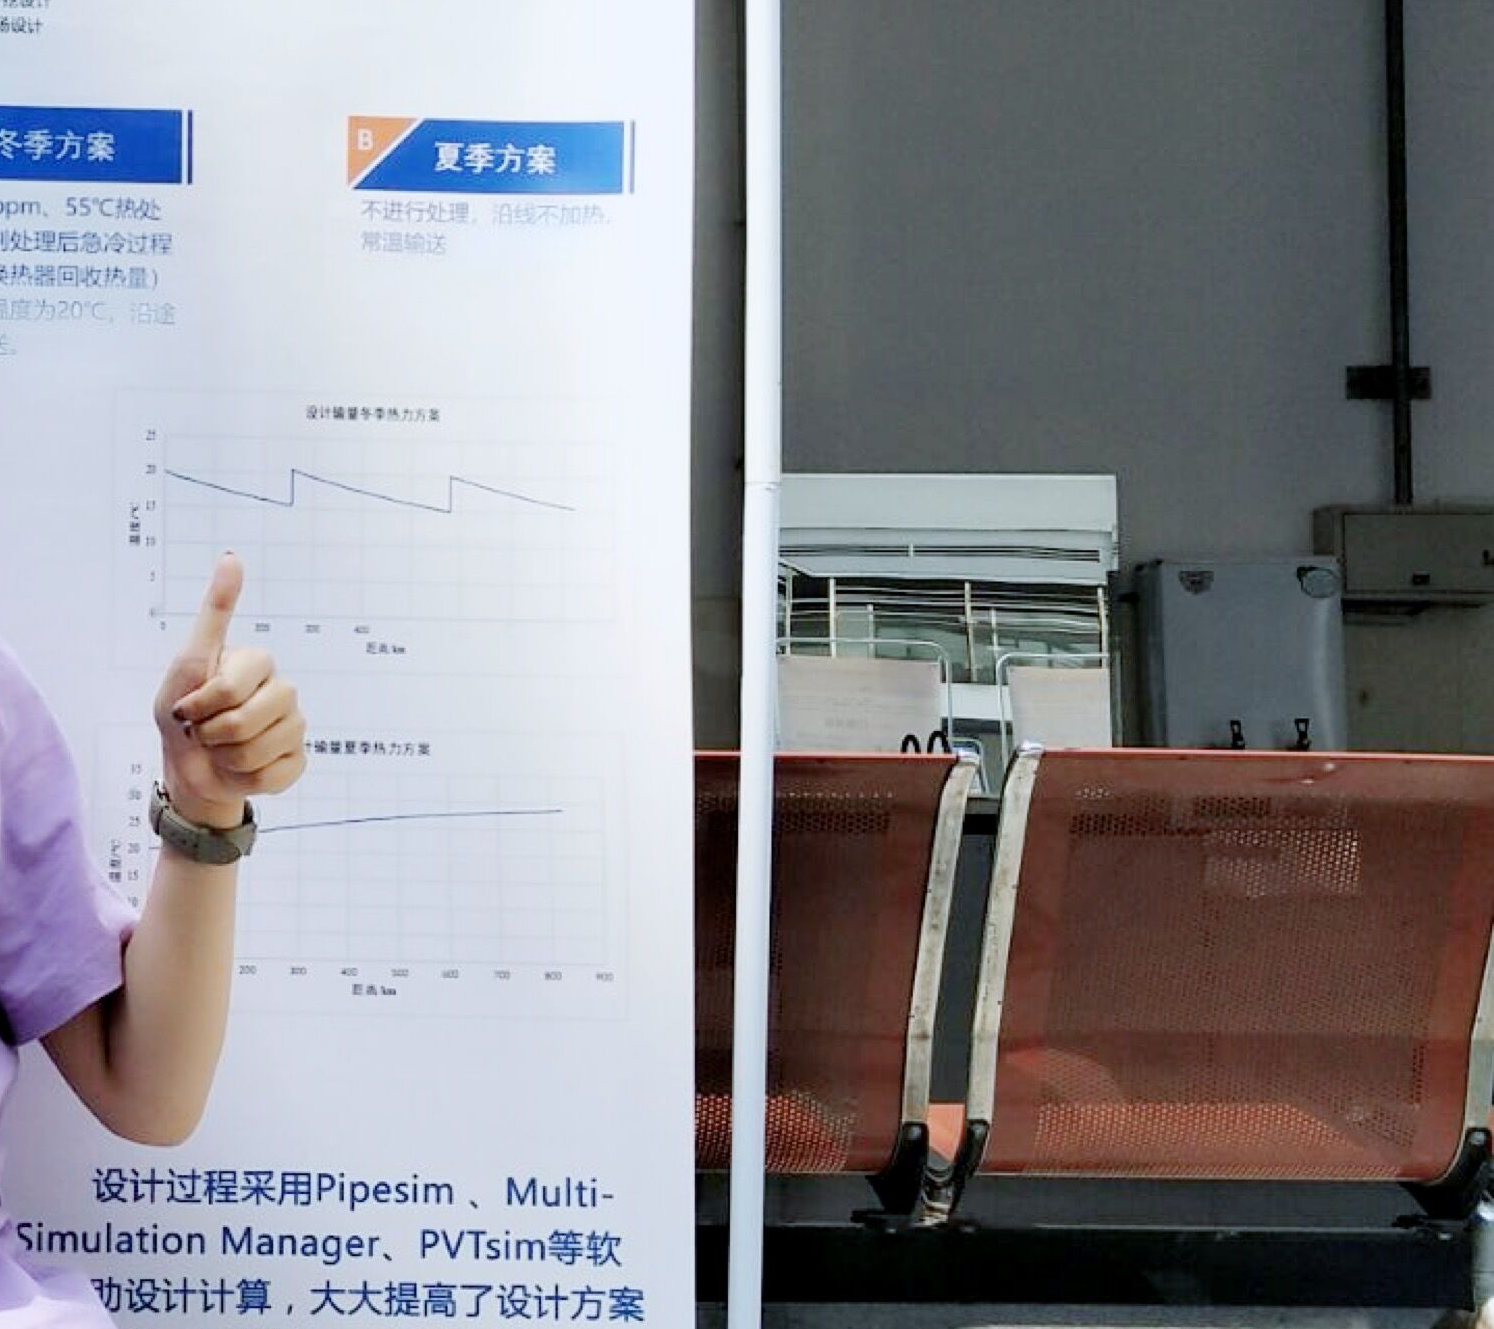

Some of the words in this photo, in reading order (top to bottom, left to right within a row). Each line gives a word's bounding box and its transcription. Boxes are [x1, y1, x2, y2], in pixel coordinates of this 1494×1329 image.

[357, 129, 375, 150] B
[434, 140, 557, 175] 夏季方案
[16, 1220, 206, 1256] Simulation
